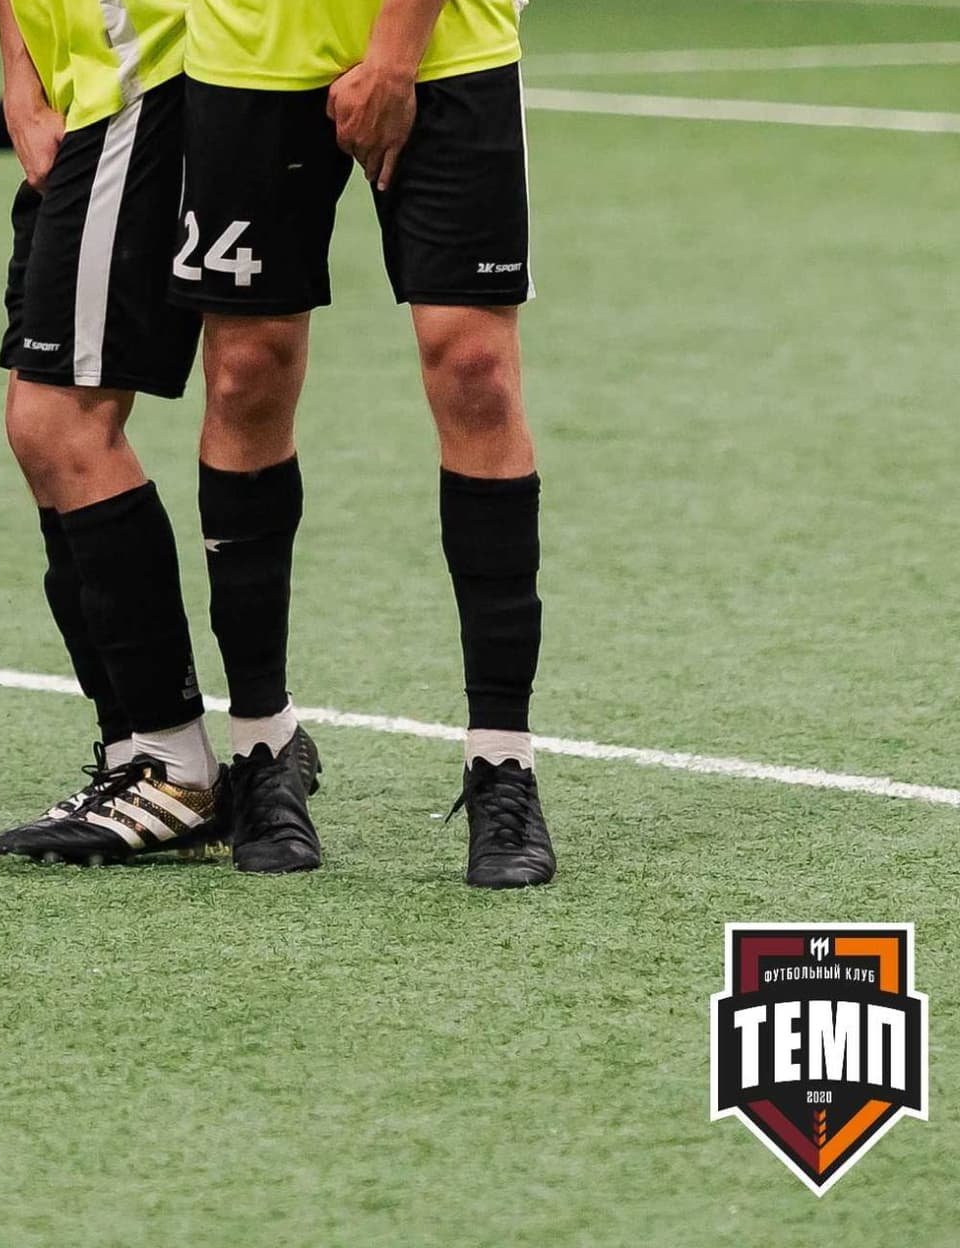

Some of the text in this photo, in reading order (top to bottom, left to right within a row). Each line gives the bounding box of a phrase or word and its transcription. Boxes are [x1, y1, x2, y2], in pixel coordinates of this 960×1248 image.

[172, 210, 262, 286] 24
[476, 262, 523, 273] 2K SPORT
